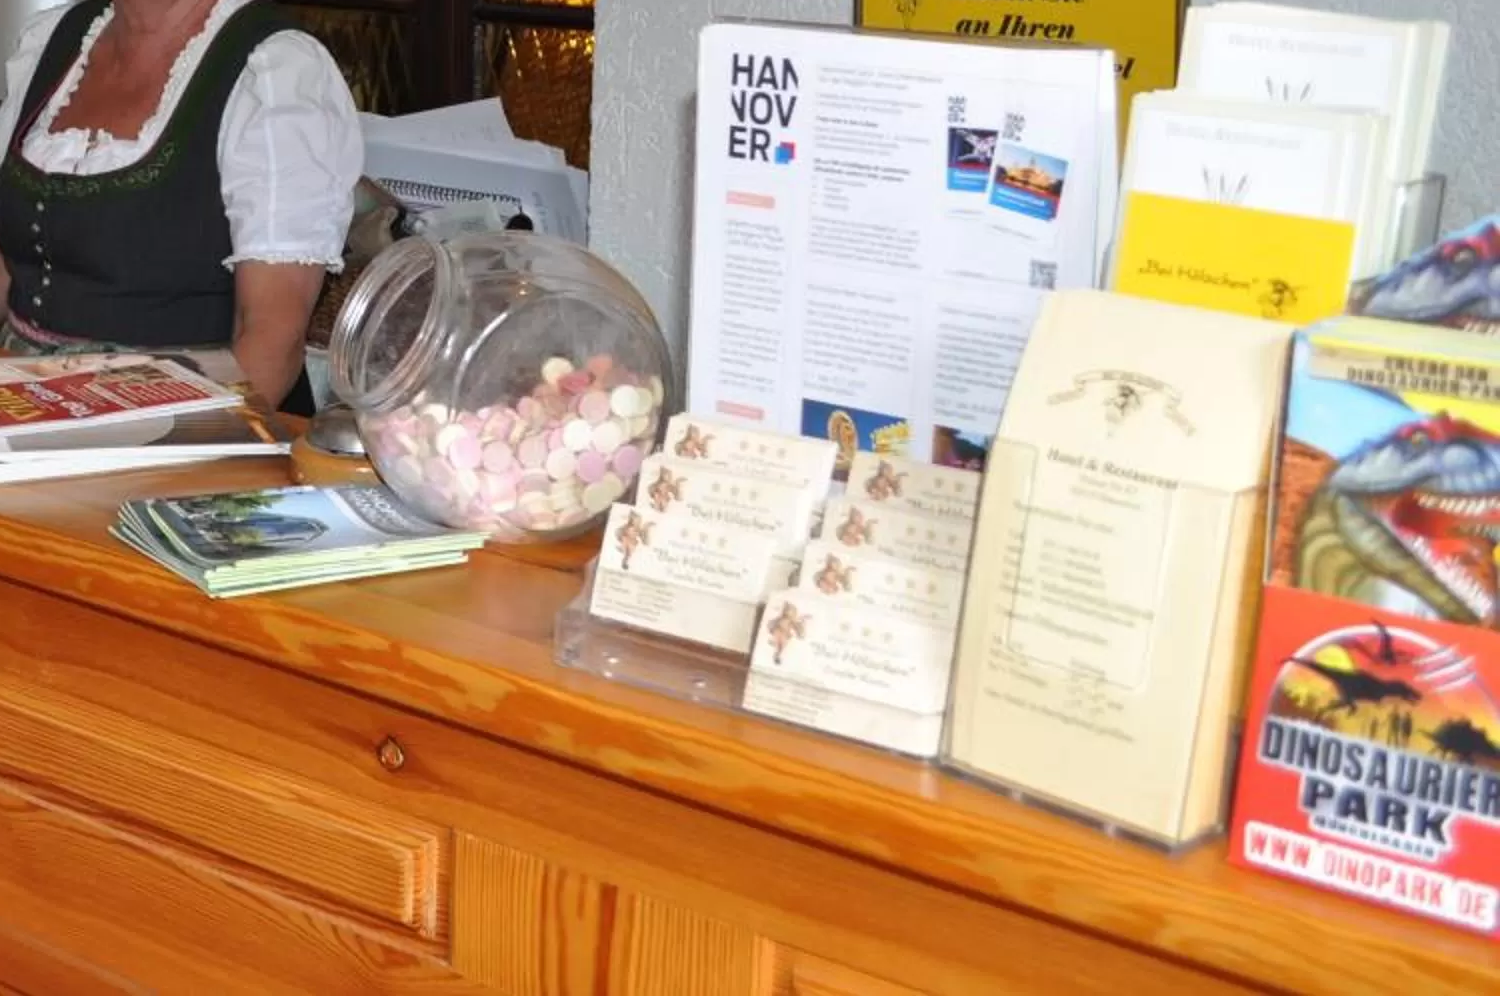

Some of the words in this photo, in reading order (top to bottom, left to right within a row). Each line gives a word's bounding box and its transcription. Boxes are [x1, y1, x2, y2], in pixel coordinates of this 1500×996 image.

[955, 18, 990, 36] an
[998, 14, 1076, 40] Ihren
[731, 53, 799, 91] HAN
[731, 90, 797, 129] NOV
[728, 125, 770, 162] ER
[1262, 720, 1500, 817] DINOSAURIER
[1302, 776, 1448, 844] PARK
[1249, 826, 1490, 921] WWWDINOPARKDE
